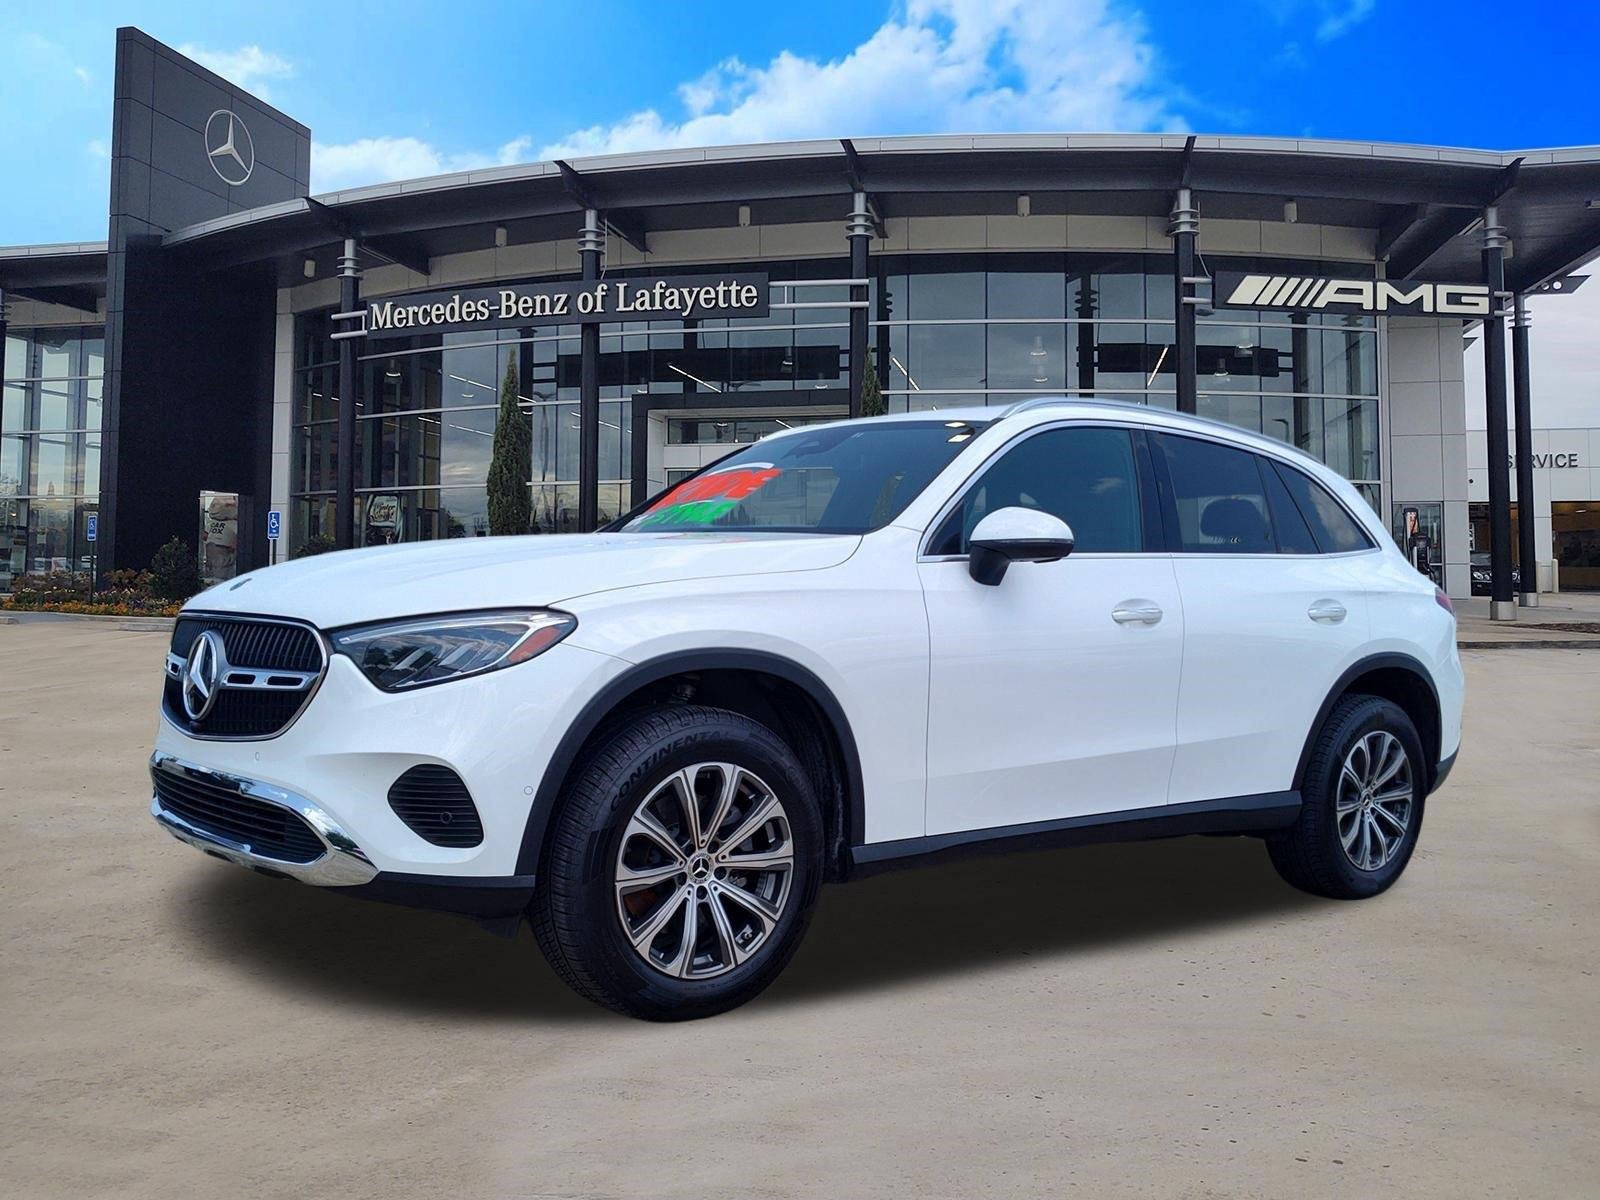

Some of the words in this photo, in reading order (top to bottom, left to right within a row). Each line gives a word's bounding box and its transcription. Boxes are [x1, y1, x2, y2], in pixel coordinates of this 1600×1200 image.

[369, 290, 568, 331] Mercedes-Benz
[577, 283, 608, 313] of
[616, 279, 758, 318] Lafayette
[1507, 453, 1578, 469] SRVICE
